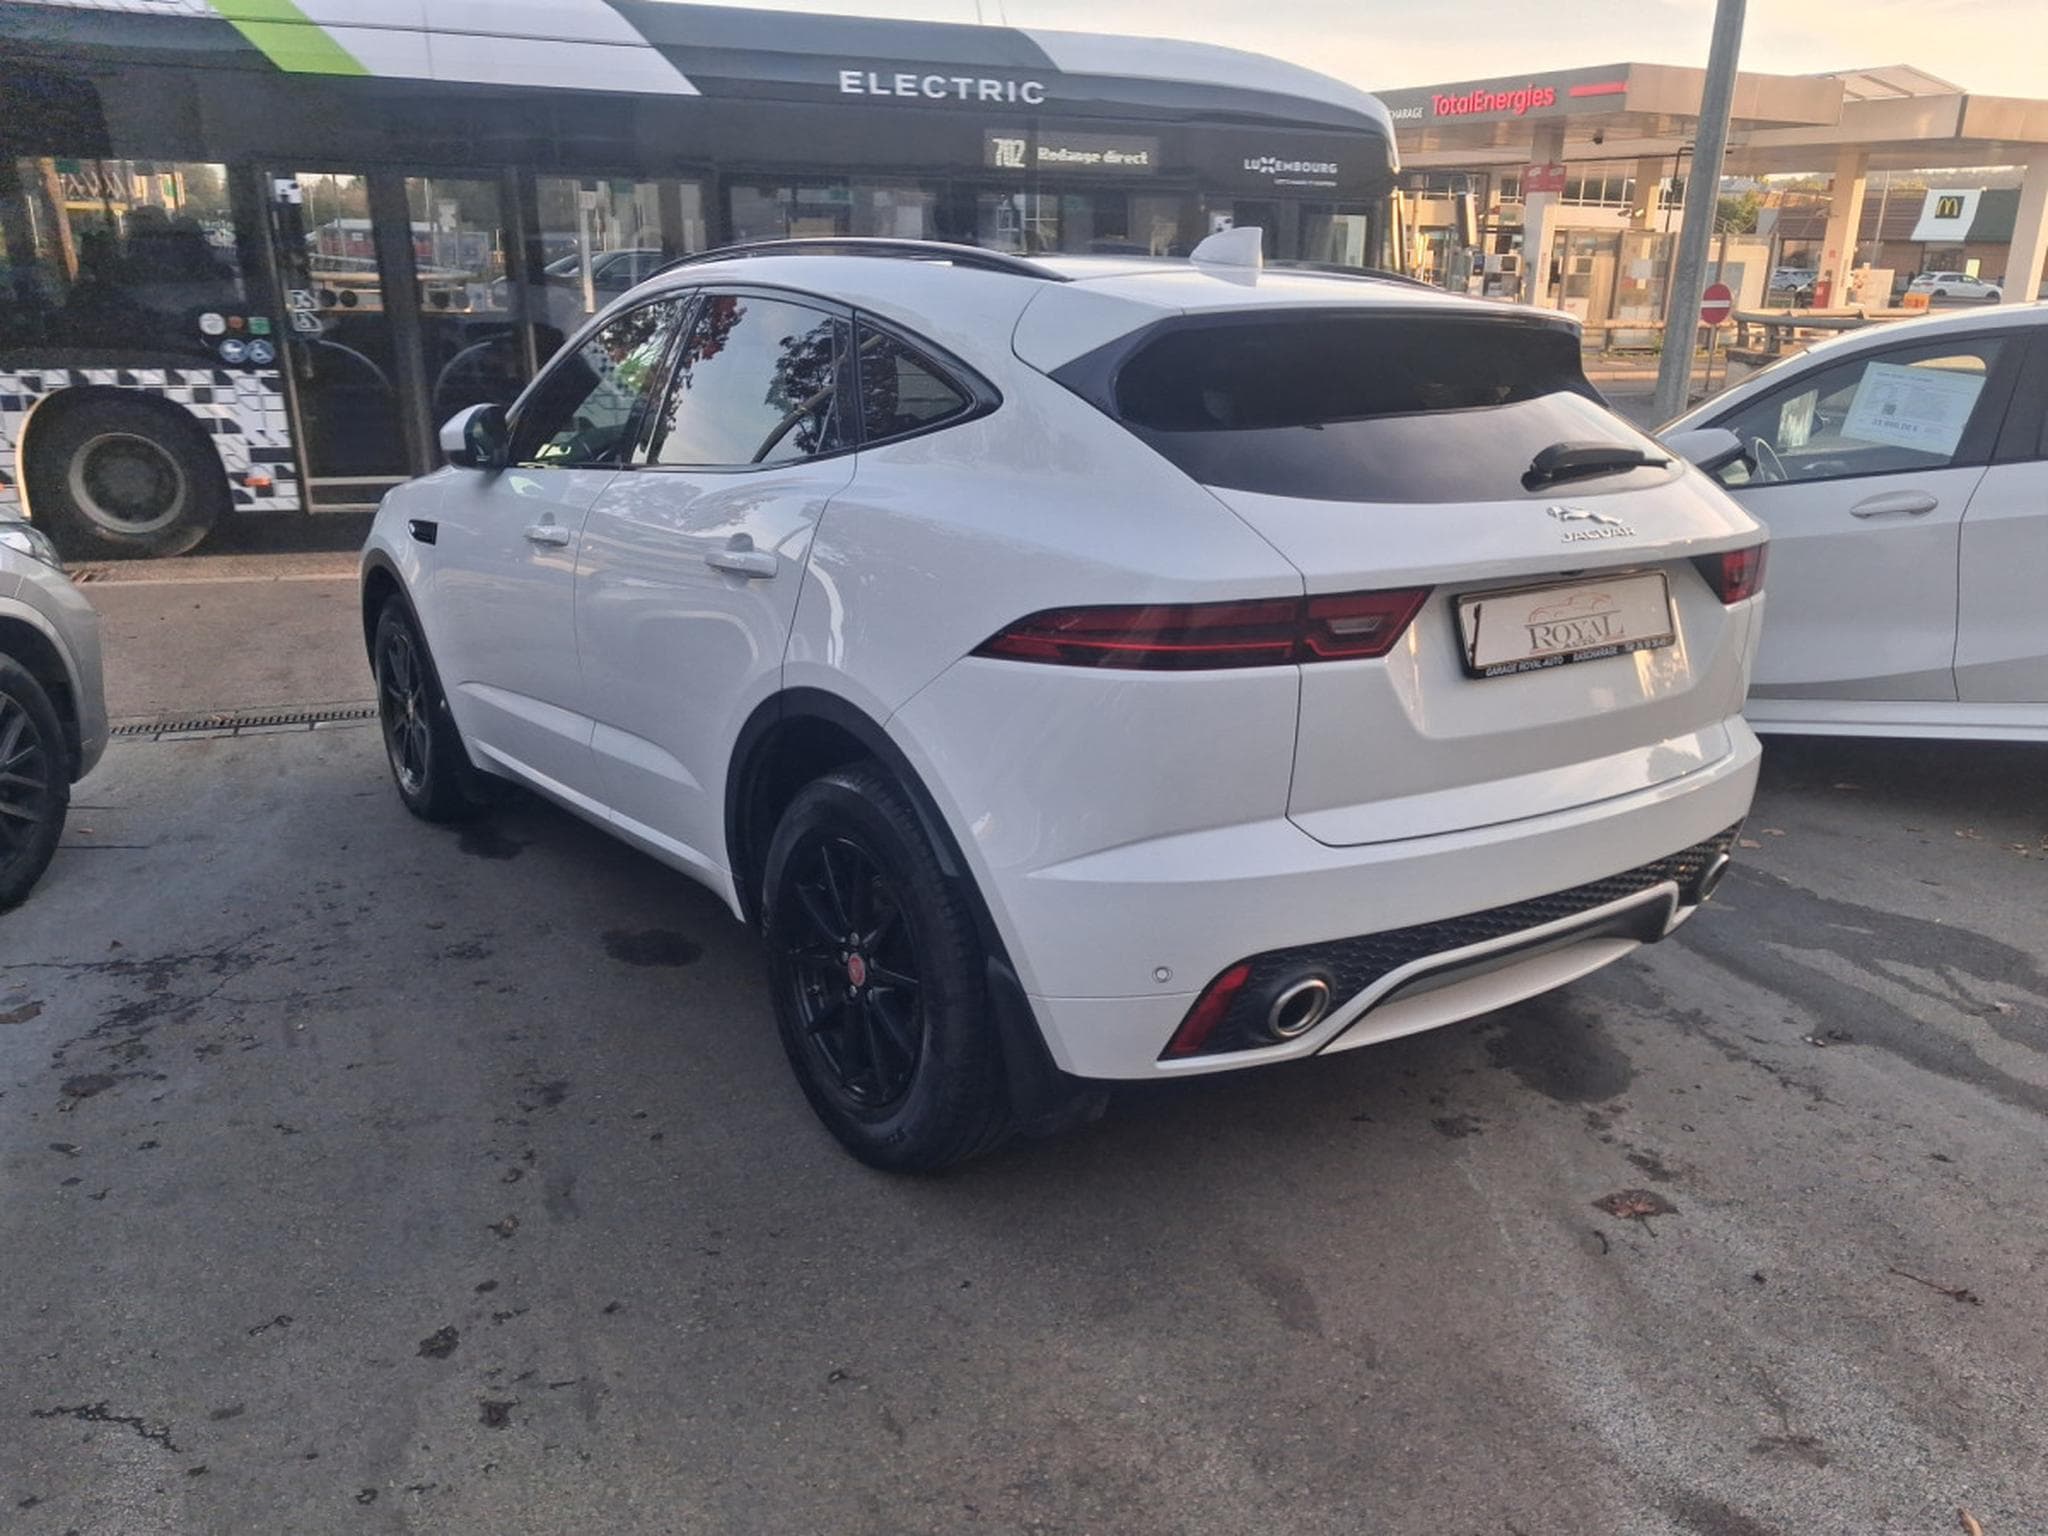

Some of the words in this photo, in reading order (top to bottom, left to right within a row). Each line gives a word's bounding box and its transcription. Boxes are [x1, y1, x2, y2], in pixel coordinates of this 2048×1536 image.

[839, 70, 1045, 105] ELECTRIC
[1432, 84, 1557, 117] TotalEnergies
[992, 138, 1027, 168] 702
[1037, 147, 1100, 164] Rodange
[1103, 150, 1148, 165] direct
[1244, 157, 1338, 174] LUXEMBOURG
[1561, 526, 1636, 543] JAGUAR
[1529, 615, 1624, 650] ROYAL
[1485, 661, 1518, 677] GARAGE
